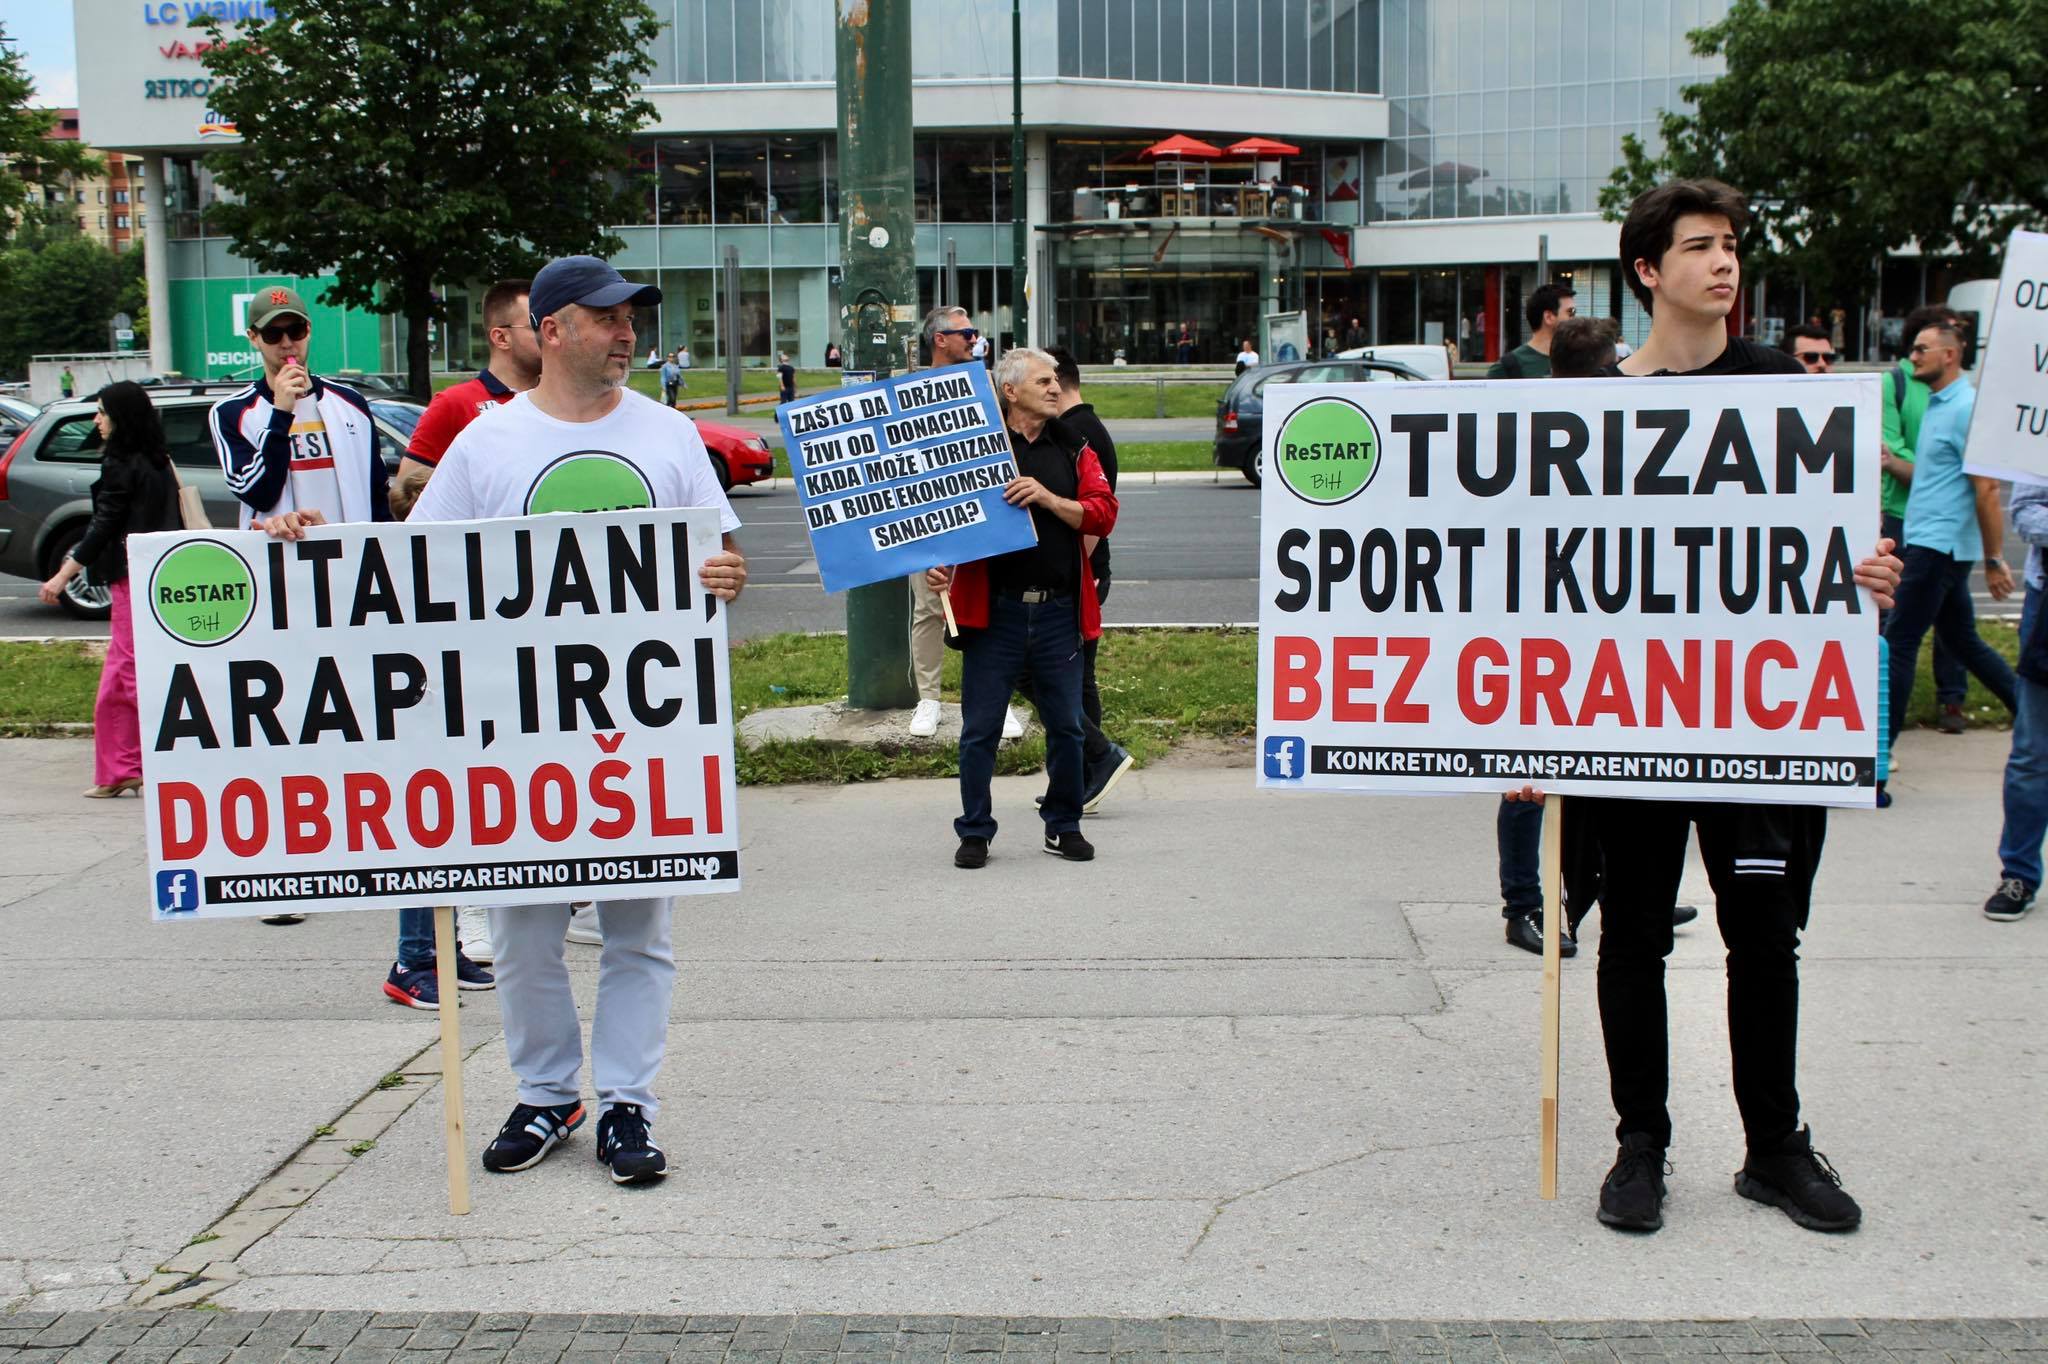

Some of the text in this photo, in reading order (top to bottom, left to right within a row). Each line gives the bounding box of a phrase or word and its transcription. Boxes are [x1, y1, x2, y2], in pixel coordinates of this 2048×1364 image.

[791, 377, 973, 435] ZAŠTO DA DRŽAVA
[803, 405, 986, 467] ŽIVI OD DONACIJA,
[806, 433, 1008, 497] KADA MOŽE TURIZAM
[1285, 441, 1372, 462] ReSTART
[1310, 470, 1343, 491] BiH
[1391, 406, 1856, 498] TURIZAM
[807, 462, 1016, 529] DA BUDE EKONOMSKA
[874, 500, 980, 548] SANACIJA?
[159, 582, 247, 605] ReSTART
[266, 521, 717, 630] ITALIJANI,
[1274, 526, 1862, 615] SPORT I KULTURA
[187, 611, 221, 633] BiH
[516, 638, 718, 734] IRCI
[1272, 635, 1866, 732] BEZ GRANICA
[157, 731, 724, 862] DOBRODOŠLI
[1327, 750, 1857, 783] KONKRETNO, TRANSPARENTNO I DOSLJEDNO
[220, 856, 721, 900] KONKRETNO, TRANSPARENTNO I DOSLJEDNO
